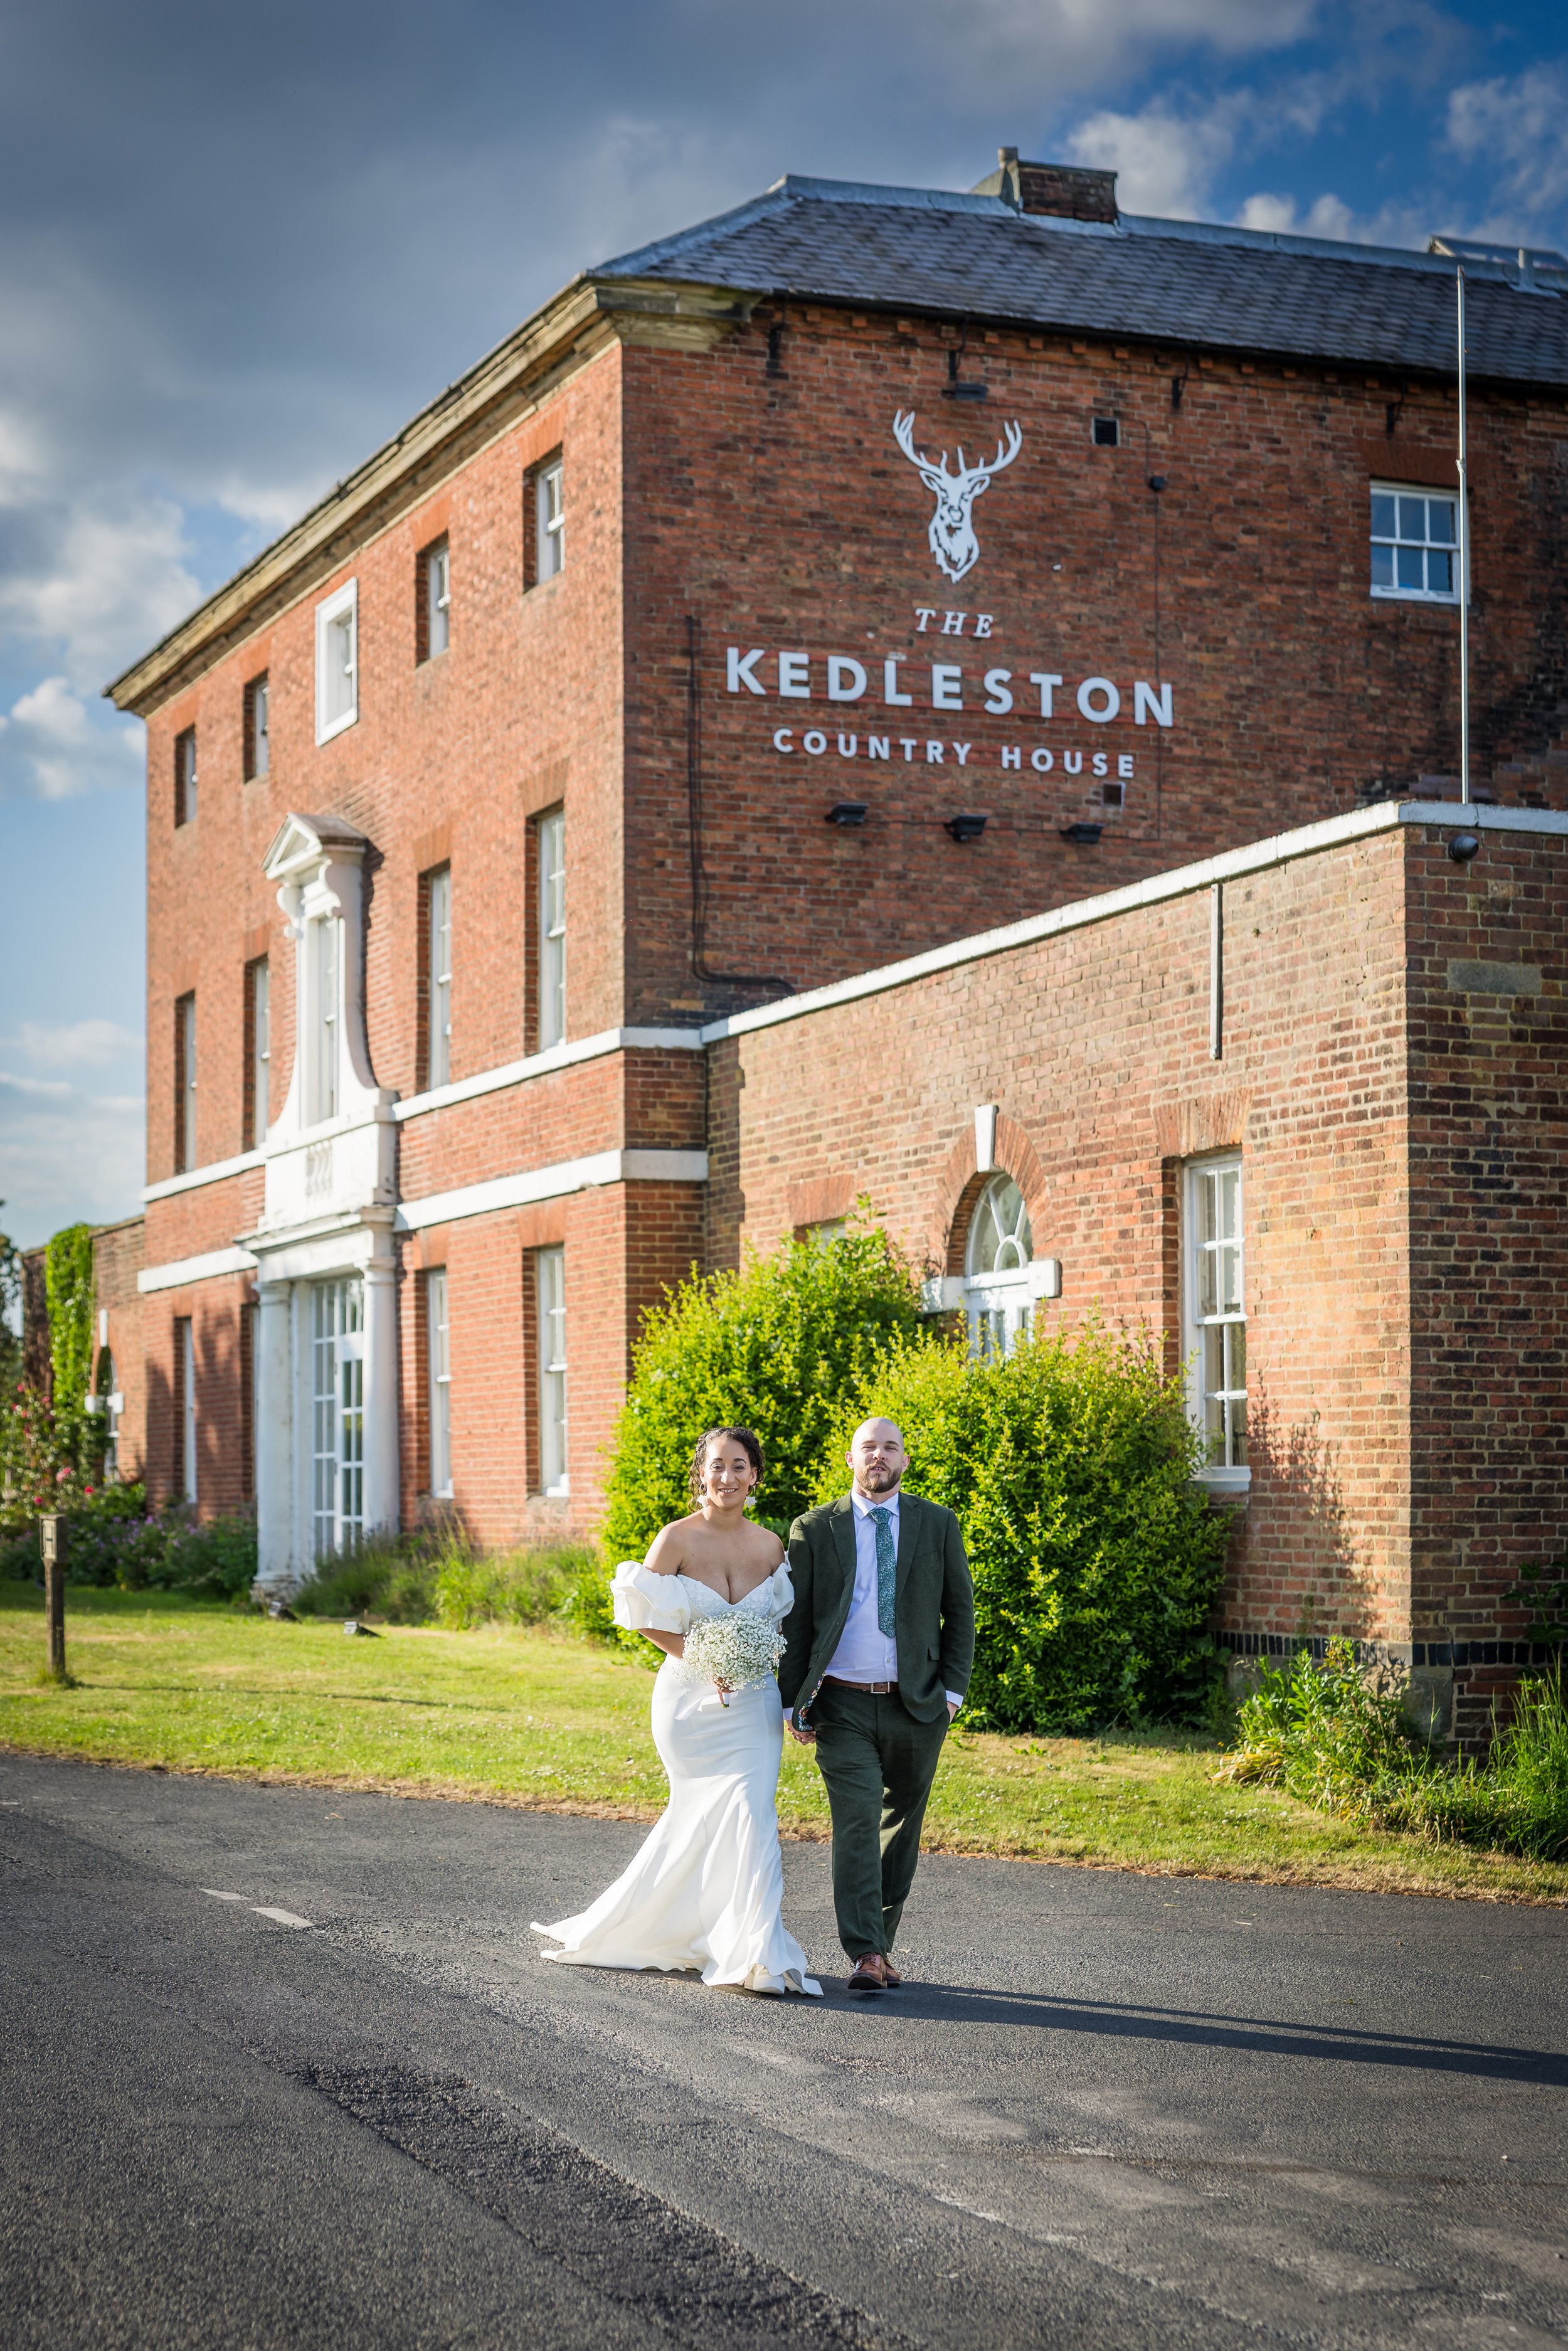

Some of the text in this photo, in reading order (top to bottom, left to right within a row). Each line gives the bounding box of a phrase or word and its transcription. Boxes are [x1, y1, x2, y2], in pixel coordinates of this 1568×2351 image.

[914, 607, 995, 639] THE
[726, 646, 1174, 728] KEDLESTON
[773, 728, 1136, 778] COUNTRY HOUSE
